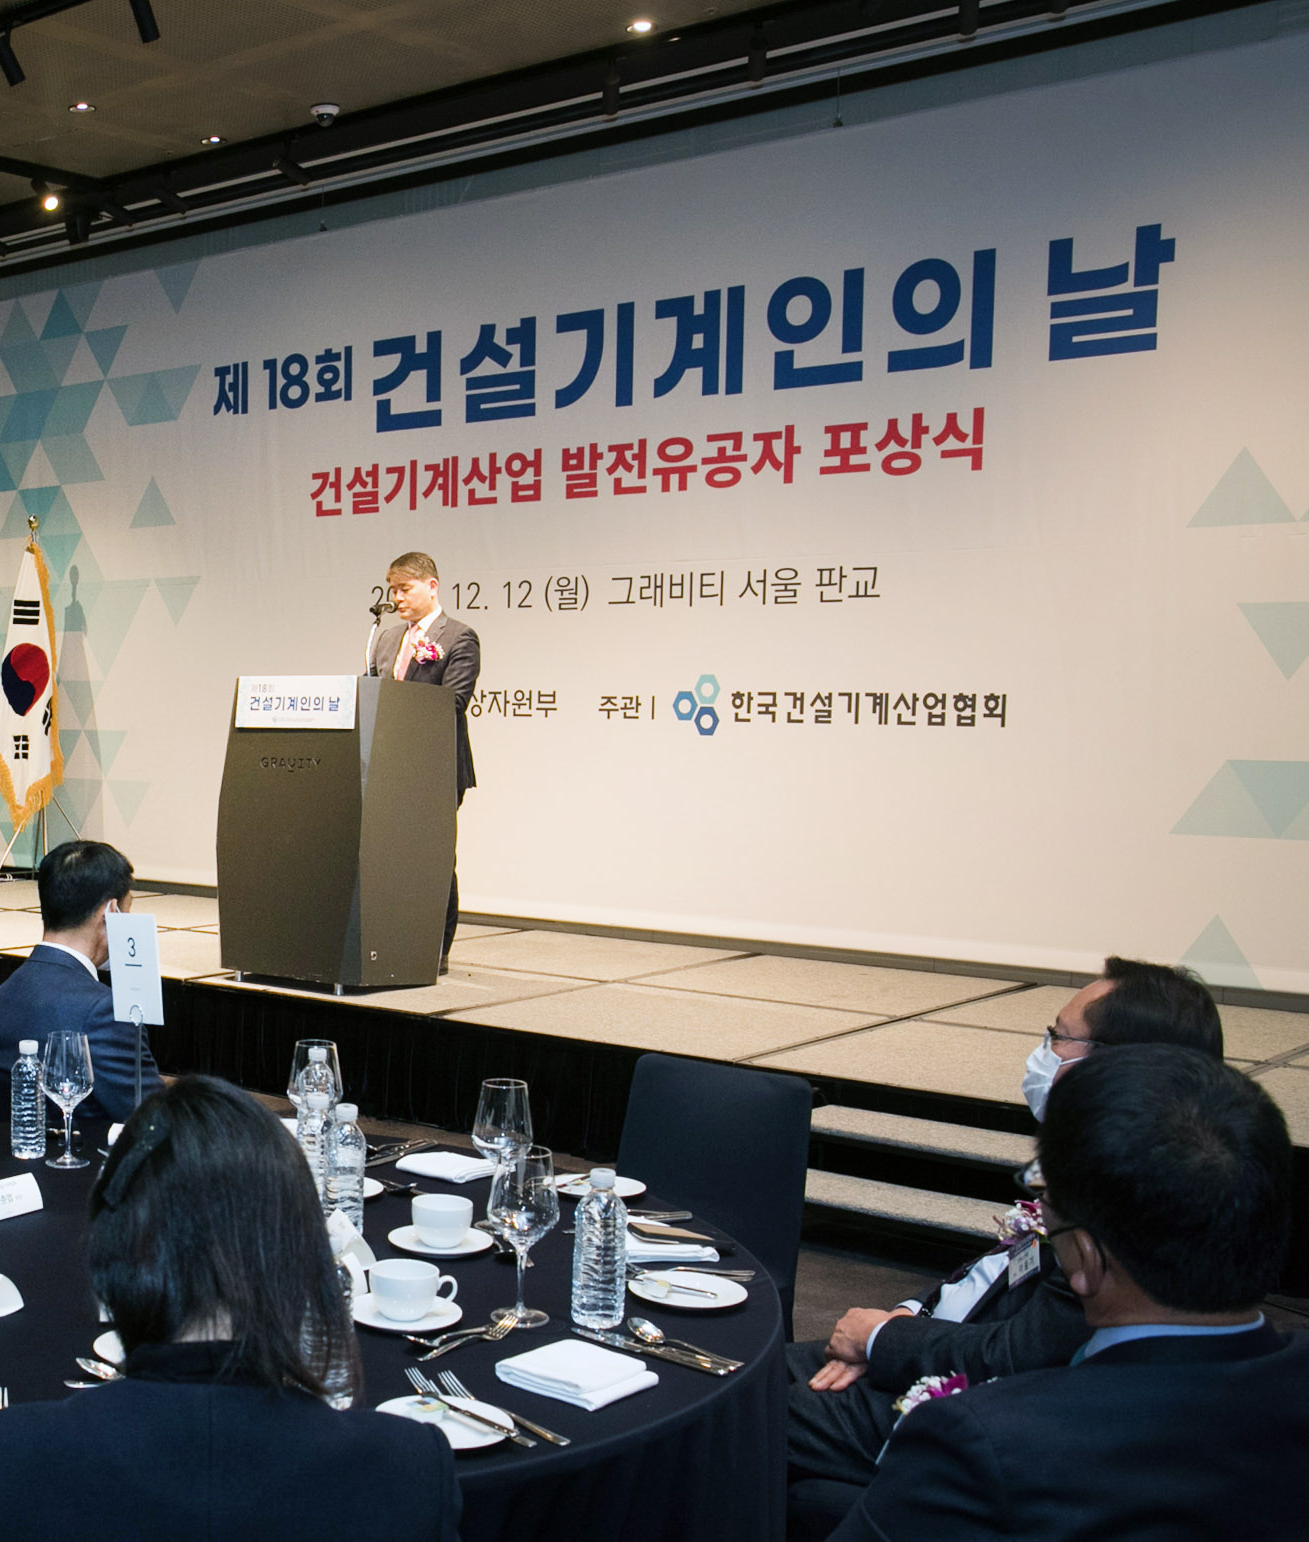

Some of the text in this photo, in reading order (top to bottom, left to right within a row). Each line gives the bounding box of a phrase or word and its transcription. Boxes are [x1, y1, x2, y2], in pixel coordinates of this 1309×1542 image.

[213, 222, 1177, 433] 제 18회 건설기계인의 날
[310, 406, 986, 518] 건설기계산업 발전유공자 포상식
[452, 565, 881, 612] 12. 12 (월) 그래비티 서울 판교
[250, 696, 341, 712] 건설기계인의 날
[598, 695, 642, 720] 주관
[731, 691, 1007, 728] 한국건설기계산업협회
[260, 756, 322, 773] GRAVITY
[127, 937, 137, 957] 3
